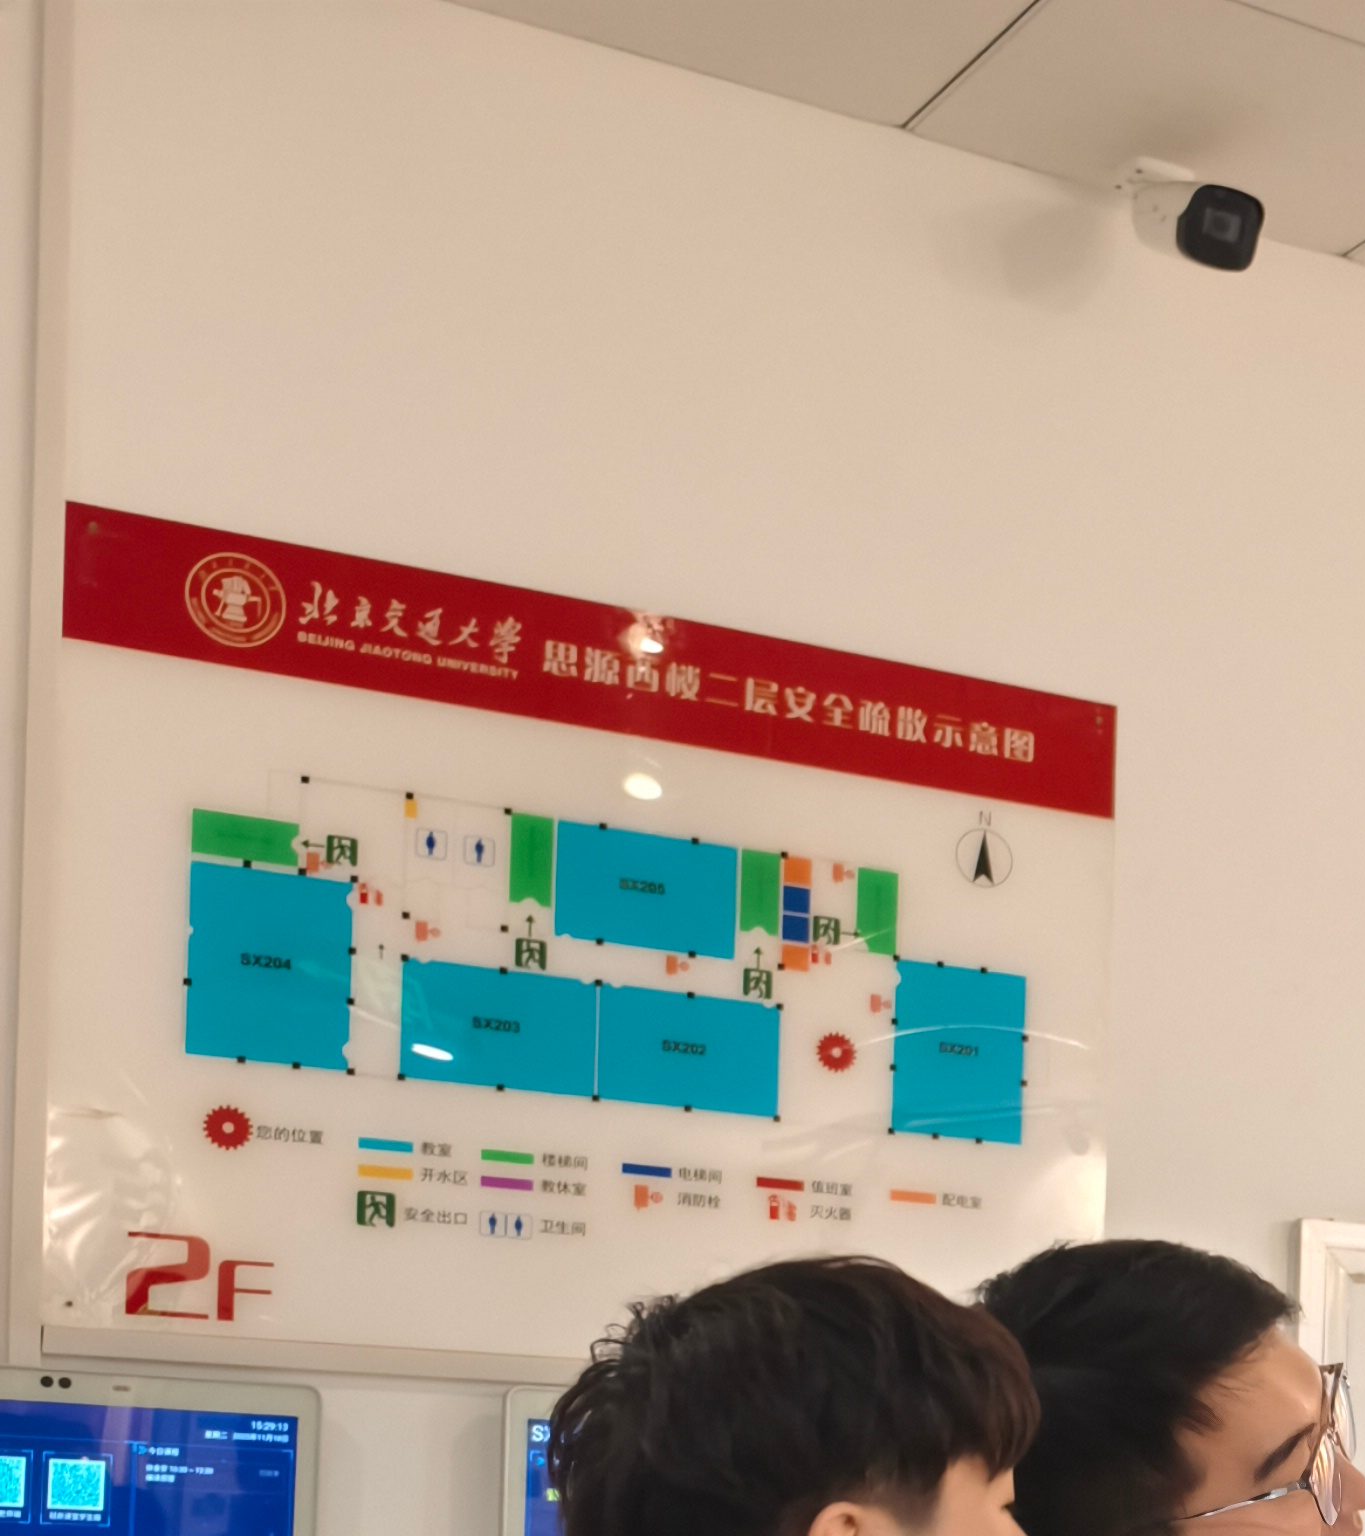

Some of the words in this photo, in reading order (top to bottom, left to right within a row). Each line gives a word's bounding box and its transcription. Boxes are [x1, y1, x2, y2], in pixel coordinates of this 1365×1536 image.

[297, 631, 355, 652] BEIJING
[360, 641, 432, 666] JIAOTONG
[437, 655, 519, 680] UNIVERSITY
[543, 640, 1035, 762] 思源西楼二层安全疏散示意图
[978, 811, 992, 826] N
[241, 952, 292, 971] SX204
[472, 1016, 520, 1033] SX203
[662, 1039, 706, 1056] SX202
[256, 1125, 324, 1145] 您的位置
[421, 1141, 452, 1158] 教室
[541, 1154, 589, 1171] 楼梯间
[420, 1168, 469, 1186] 开水区
[678, 1167, 723, 1184] 电梯间
[811, 1180, 853, 1196] 值班室
[677, 1192, 721, 1209] 消防栓
[942, 1193, 982, 1209] 配电室
[403, 1207, 468, 1226] 安全出口
[810, 1206, 852, 1221] 灭火器
[539, 1219, 587, 1237] 卫生间
[125, 1231, 274, 1321] 2F
